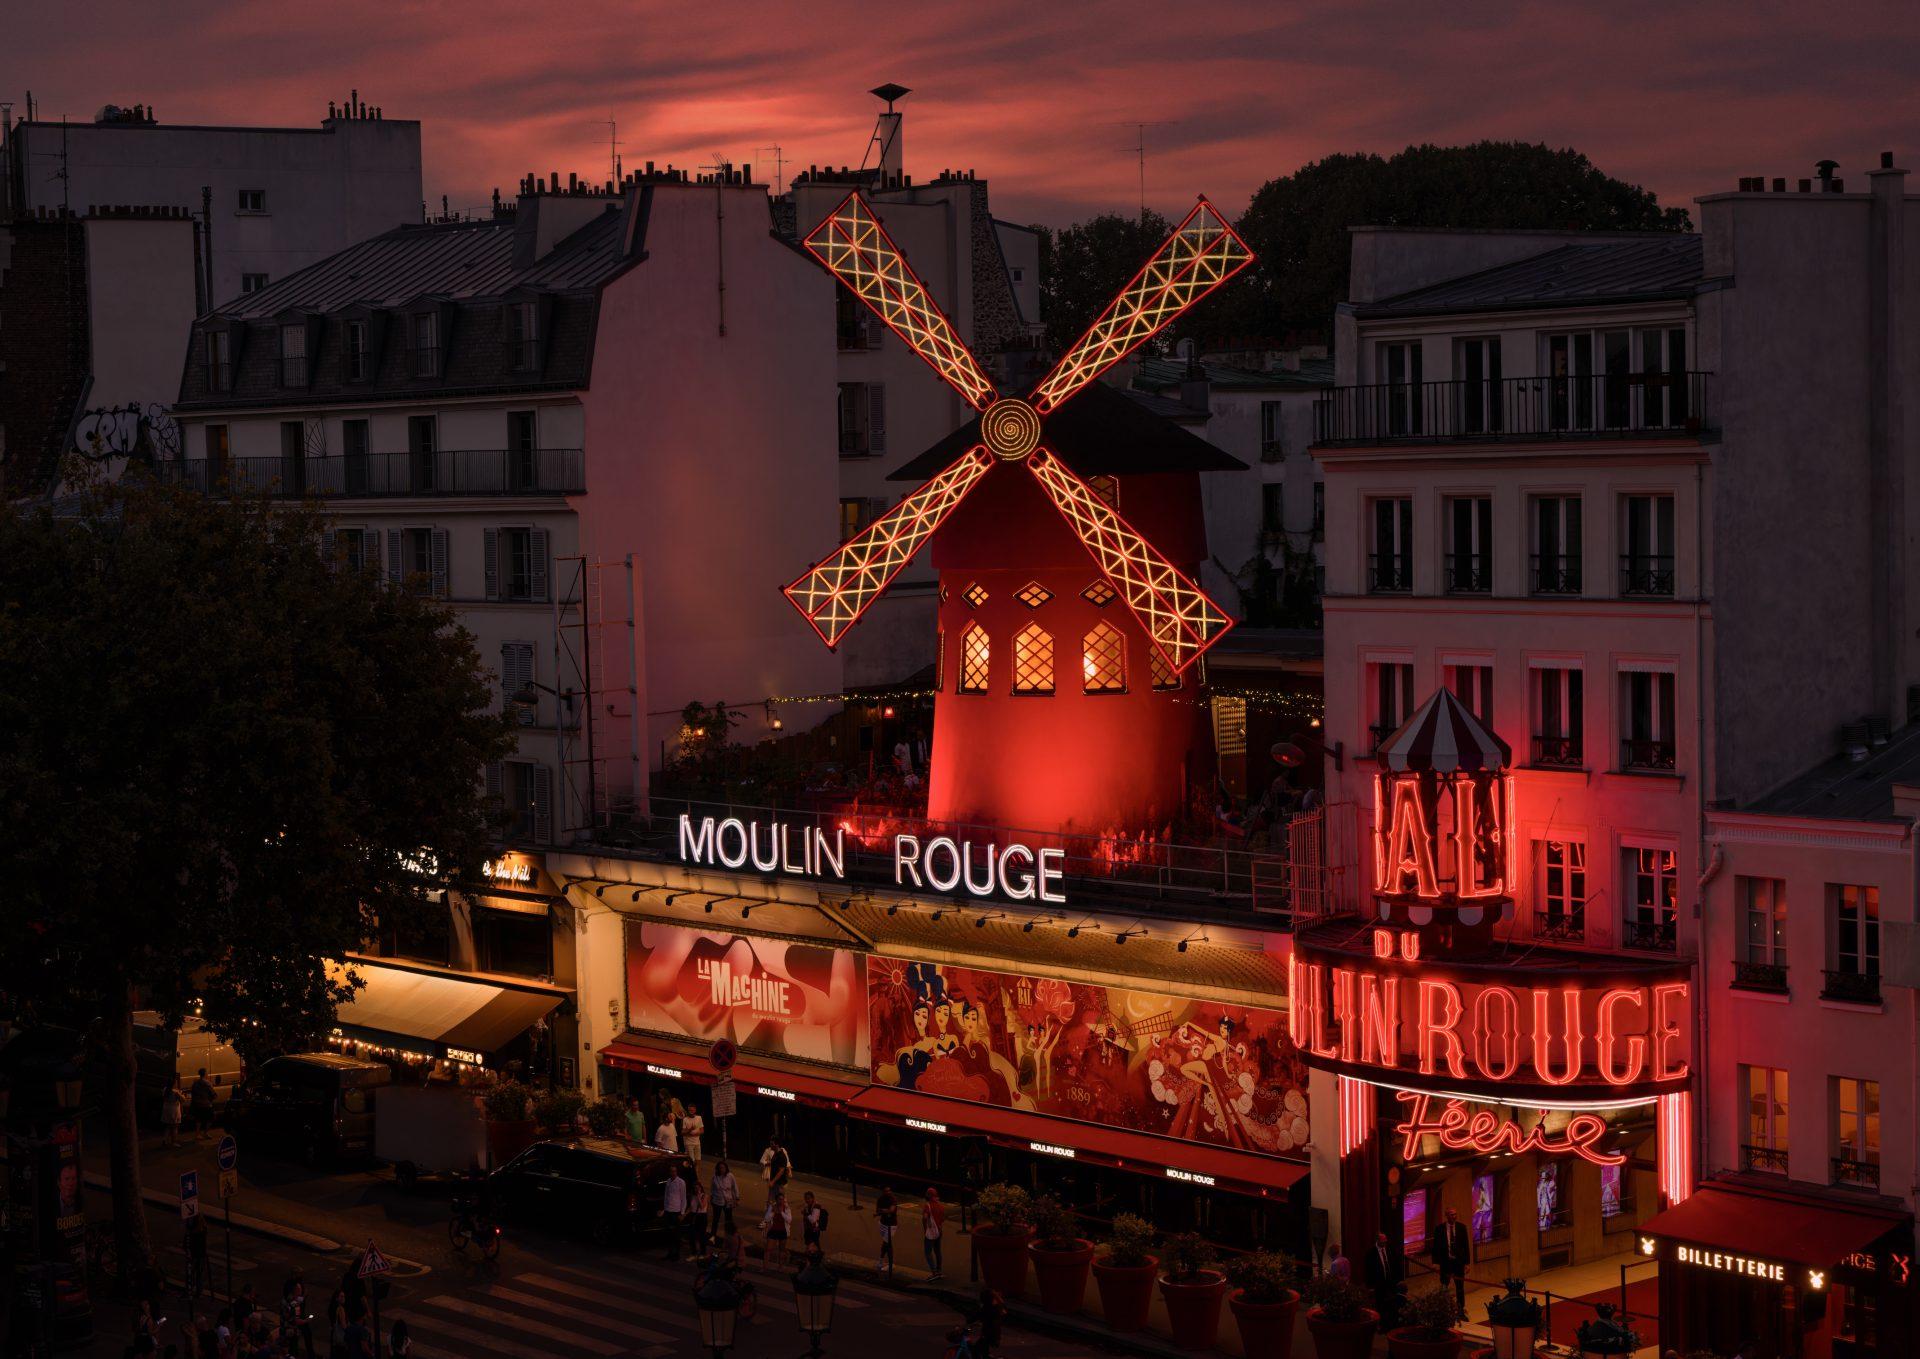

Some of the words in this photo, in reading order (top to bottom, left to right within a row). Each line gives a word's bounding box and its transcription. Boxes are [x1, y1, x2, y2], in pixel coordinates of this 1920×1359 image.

[1374, 774, 1503, 898] AL
[679, 813, 847, 879] MOULIN
[895, 834, 1067, 903] ROUGE
[1374, 929, 1420, 962] DU
[697, 957, 711, 975] LA
[1417, 981, 1689, 1086] ROUGE
[1066, 1086, 1091, 1105] 1889
[905, 1118, 927, 1129] MOULIN
[927, 1122, 947, 1133] ROUGE
[1396, 1090, 1628, 1167] Féerie
[1030, 1142, 1053, 1153] MOULIN
[1054, 1147, 1075, 1158] ROUGE
[1166, 1169, 1192, 1181] MOULIN
[1192, 1174, 1215, 1186] ROUGE
[1677, 1245, 1785, 1282] BILLETTERIE
